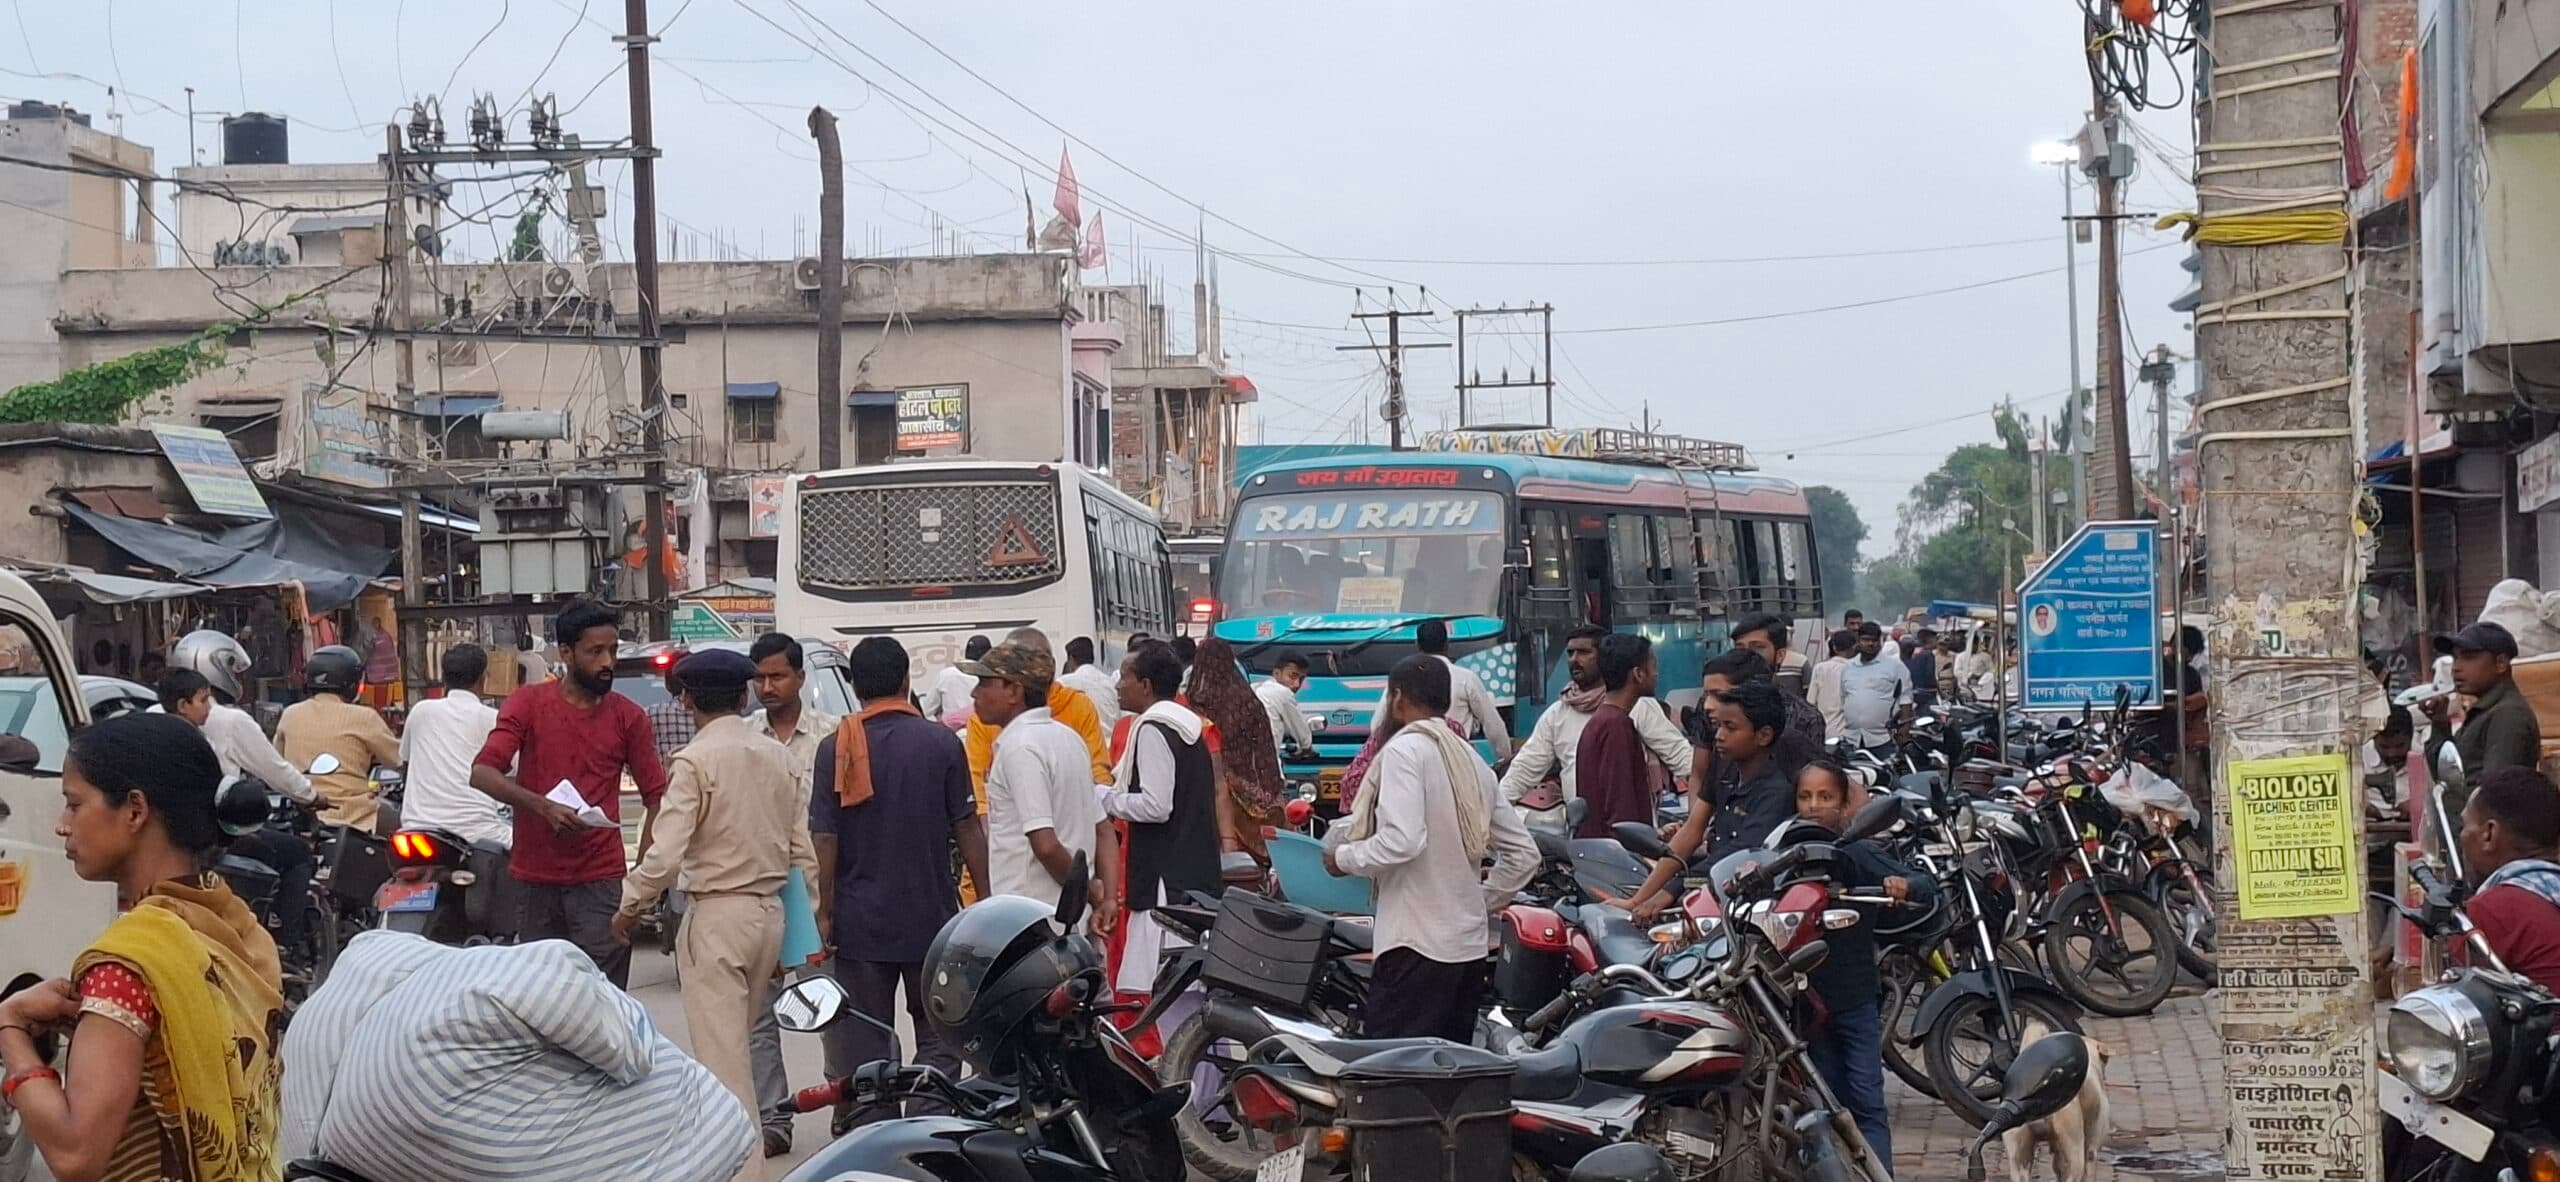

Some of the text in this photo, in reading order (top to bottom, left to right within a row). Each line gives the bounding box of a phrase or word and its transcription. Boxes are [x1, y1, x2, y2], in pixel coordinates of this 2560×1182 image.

[1297, 470, 1339, 485] जय
[1255, 500, 1480, 532] RAJ RATH
[2031, 687, 2055, 699] नगर
[2246, 774, 2335, 800] BIOLOGY
[2247, 799, 2338, 814] TEACHING CENTER
[2251, 846, 2343, 873] RANJAN SIR
